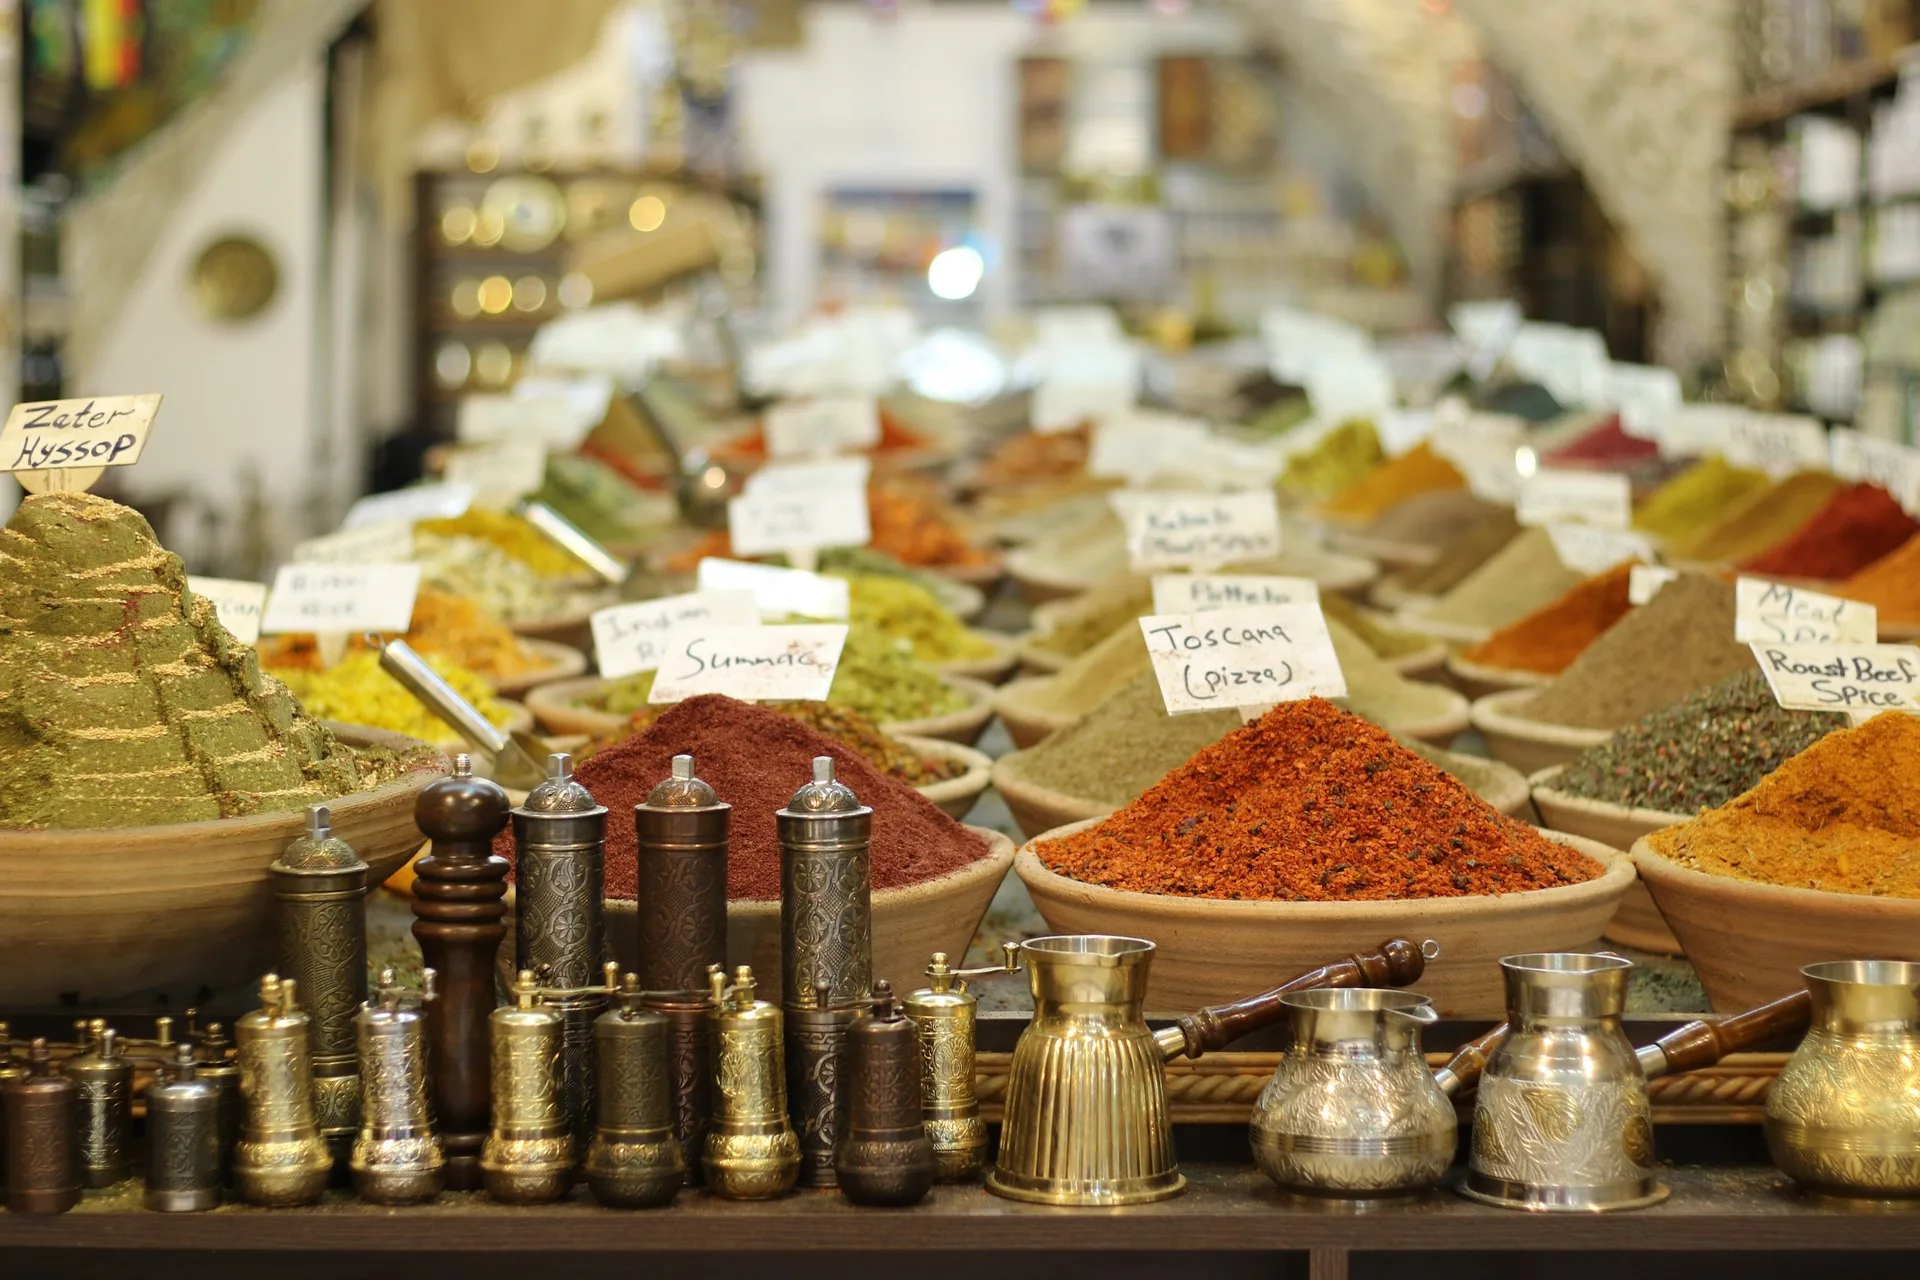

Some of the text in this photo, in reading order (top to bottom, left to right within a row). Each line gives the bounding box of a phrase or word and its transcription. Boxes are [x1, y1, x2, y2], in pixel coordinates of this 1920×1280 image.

[23, 400, 135, 430] Zater
[12, 432, 137, 469] Hyssop
[1150, 624, 1293, 651] Toscana
[1184, 660, 1293, 700] (pizza)
[1766, 649, 1918, 685] Roast Beef
[1810, 679, 1906, 707] Spice
